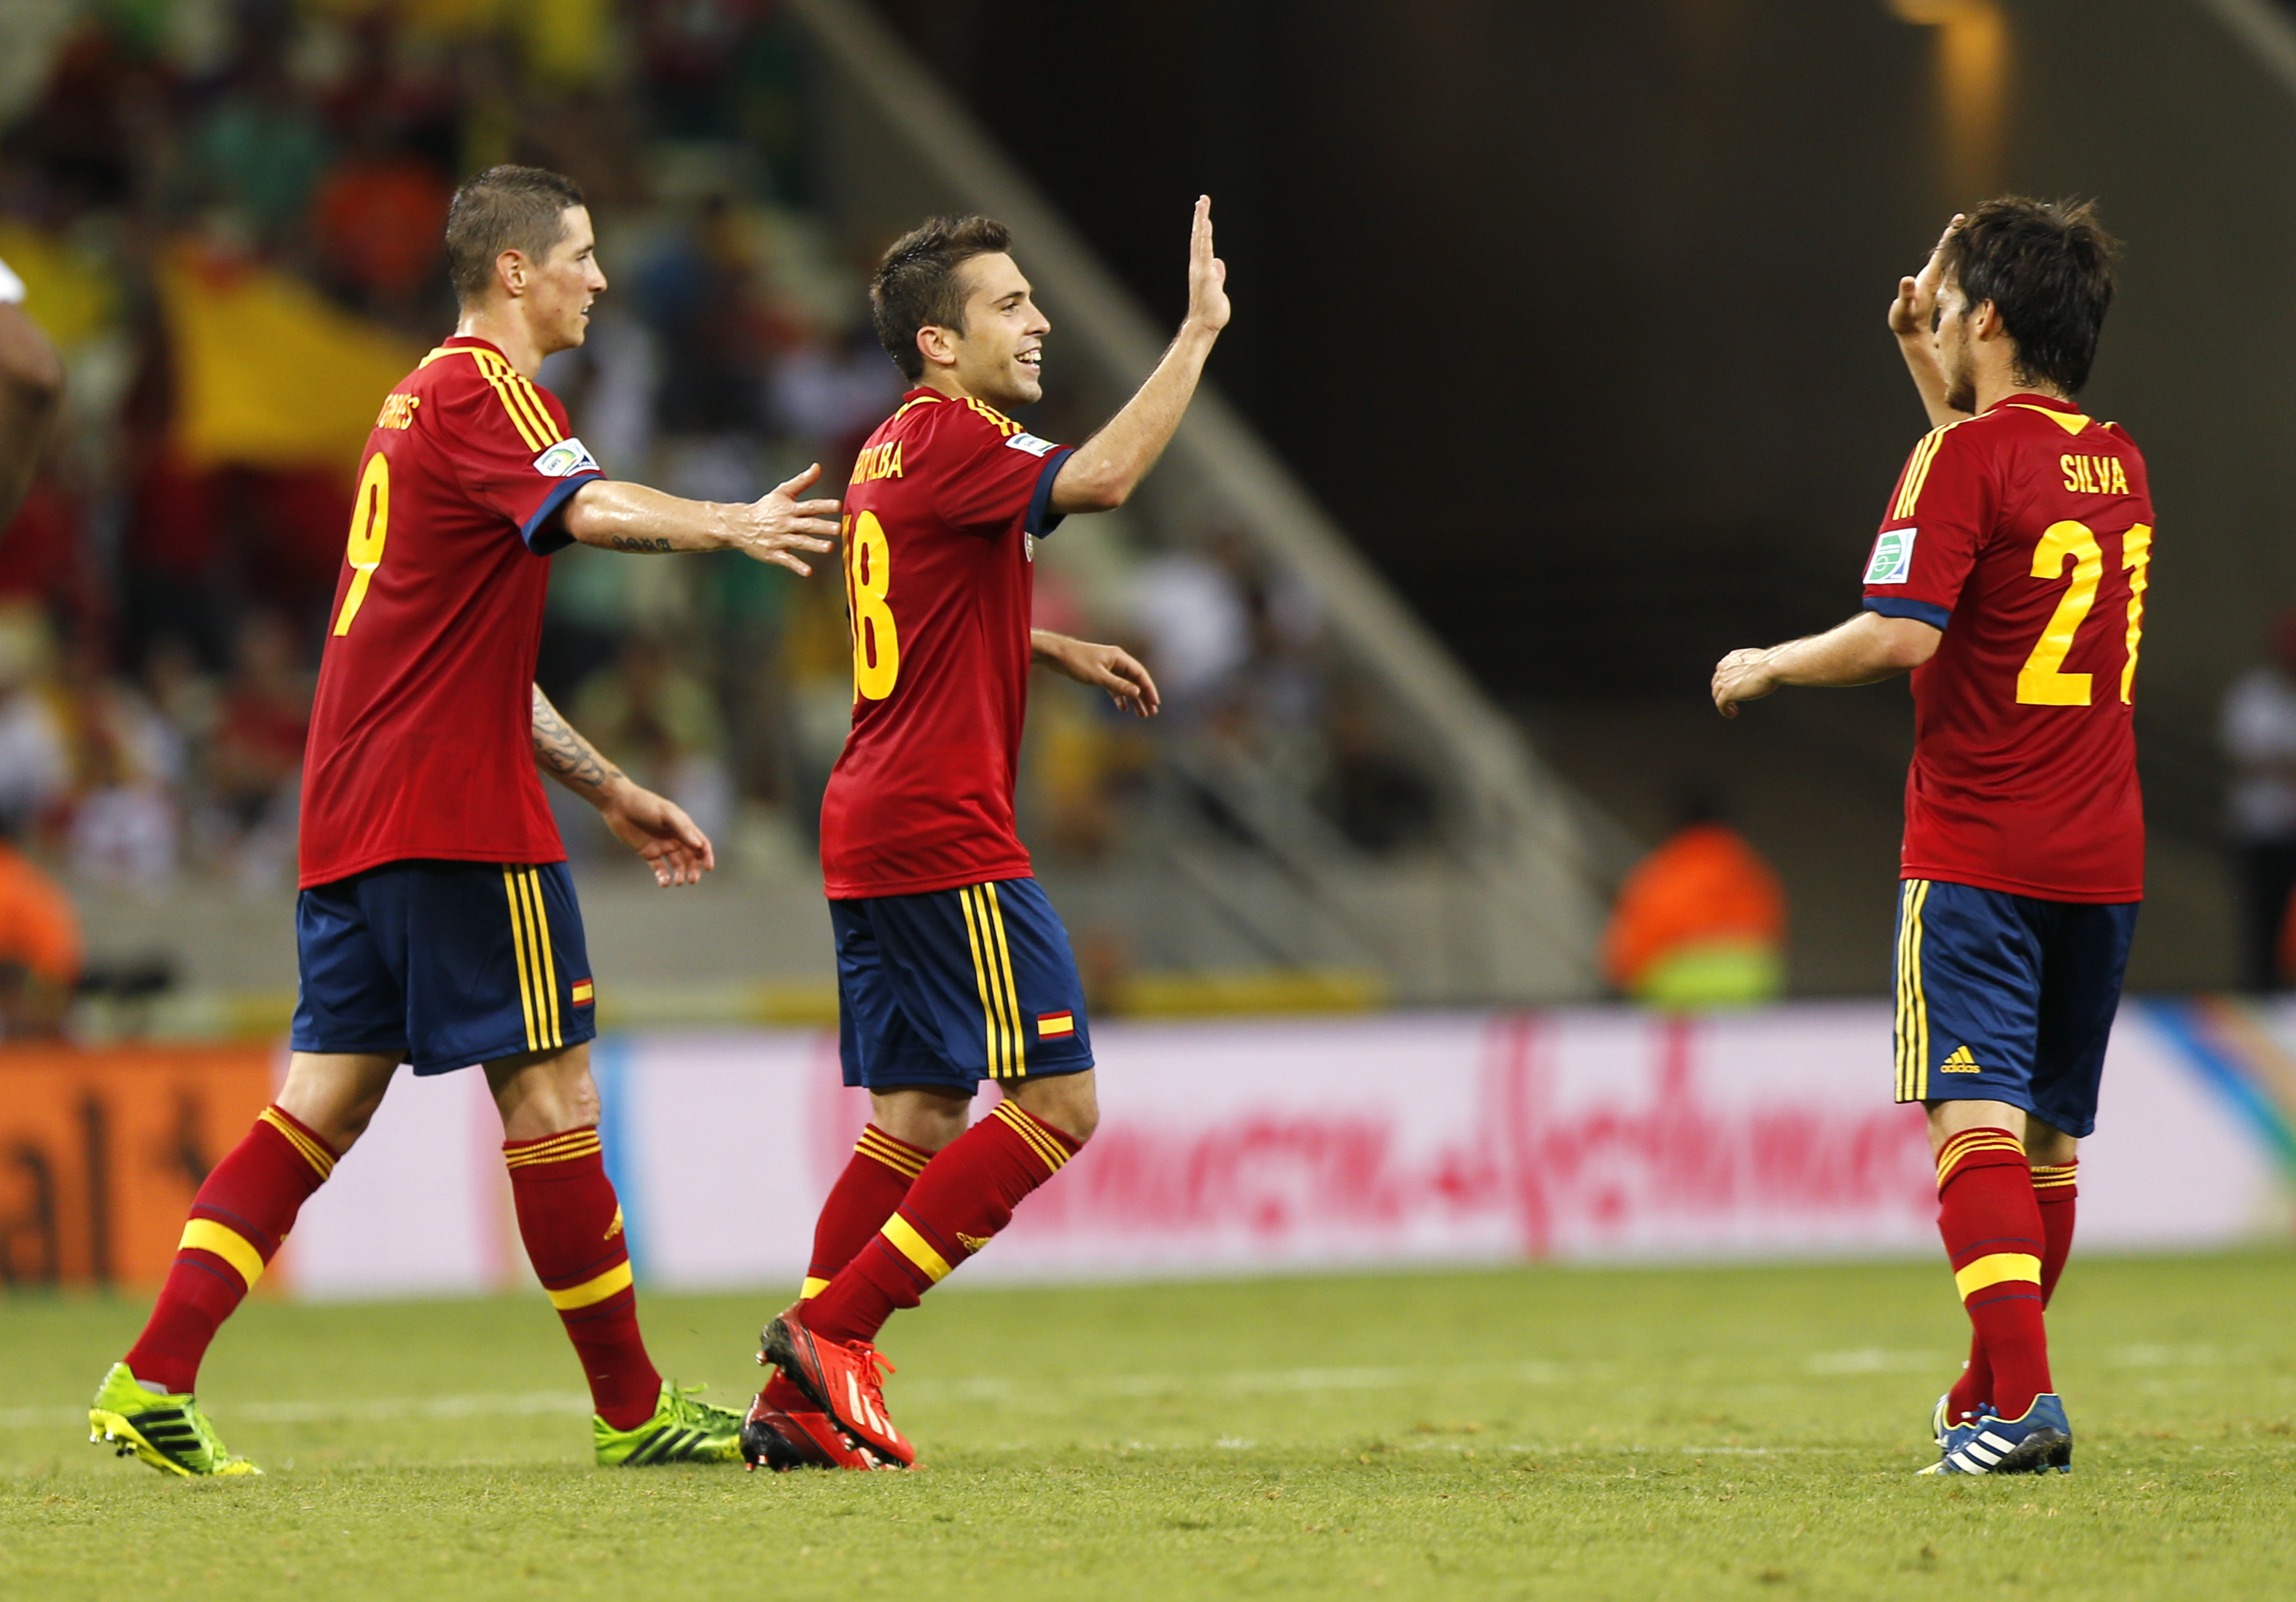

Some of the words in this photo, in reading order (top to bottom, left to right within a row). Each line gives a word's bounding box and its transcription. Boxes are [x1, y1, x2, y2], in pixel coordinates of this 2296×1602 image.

[2061, 454, 2129, 494] SILVA
[332, 451, 389, 636] 9
[2015, 520, 2152, 706] 21
[1940, 1061, 1981, 1074] adidas
